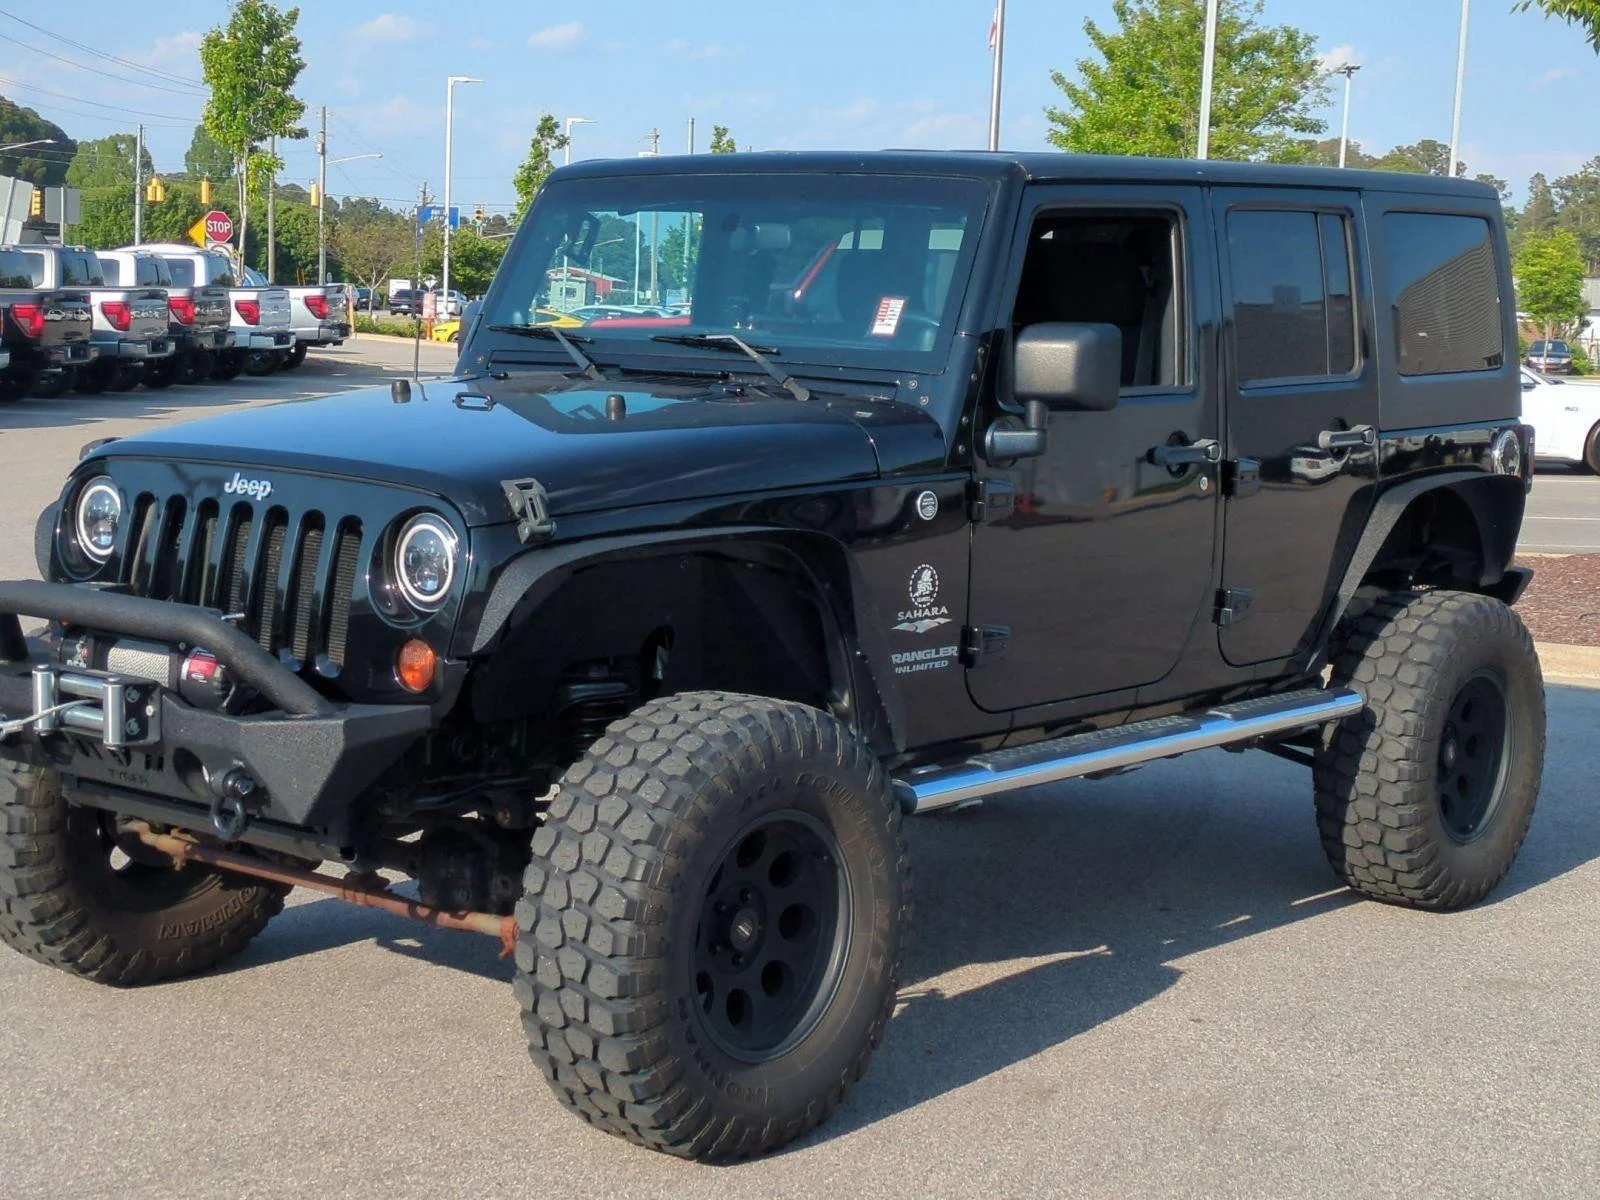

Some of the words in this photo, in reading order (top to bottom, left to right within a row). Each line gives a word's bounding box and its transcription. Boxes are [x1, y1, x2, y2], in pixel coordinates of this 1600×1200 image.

[206, 220, 231, 233] STOP
[223, 472, 272, 501] Jeep
[896, 605, 949, 621] SAHARA
